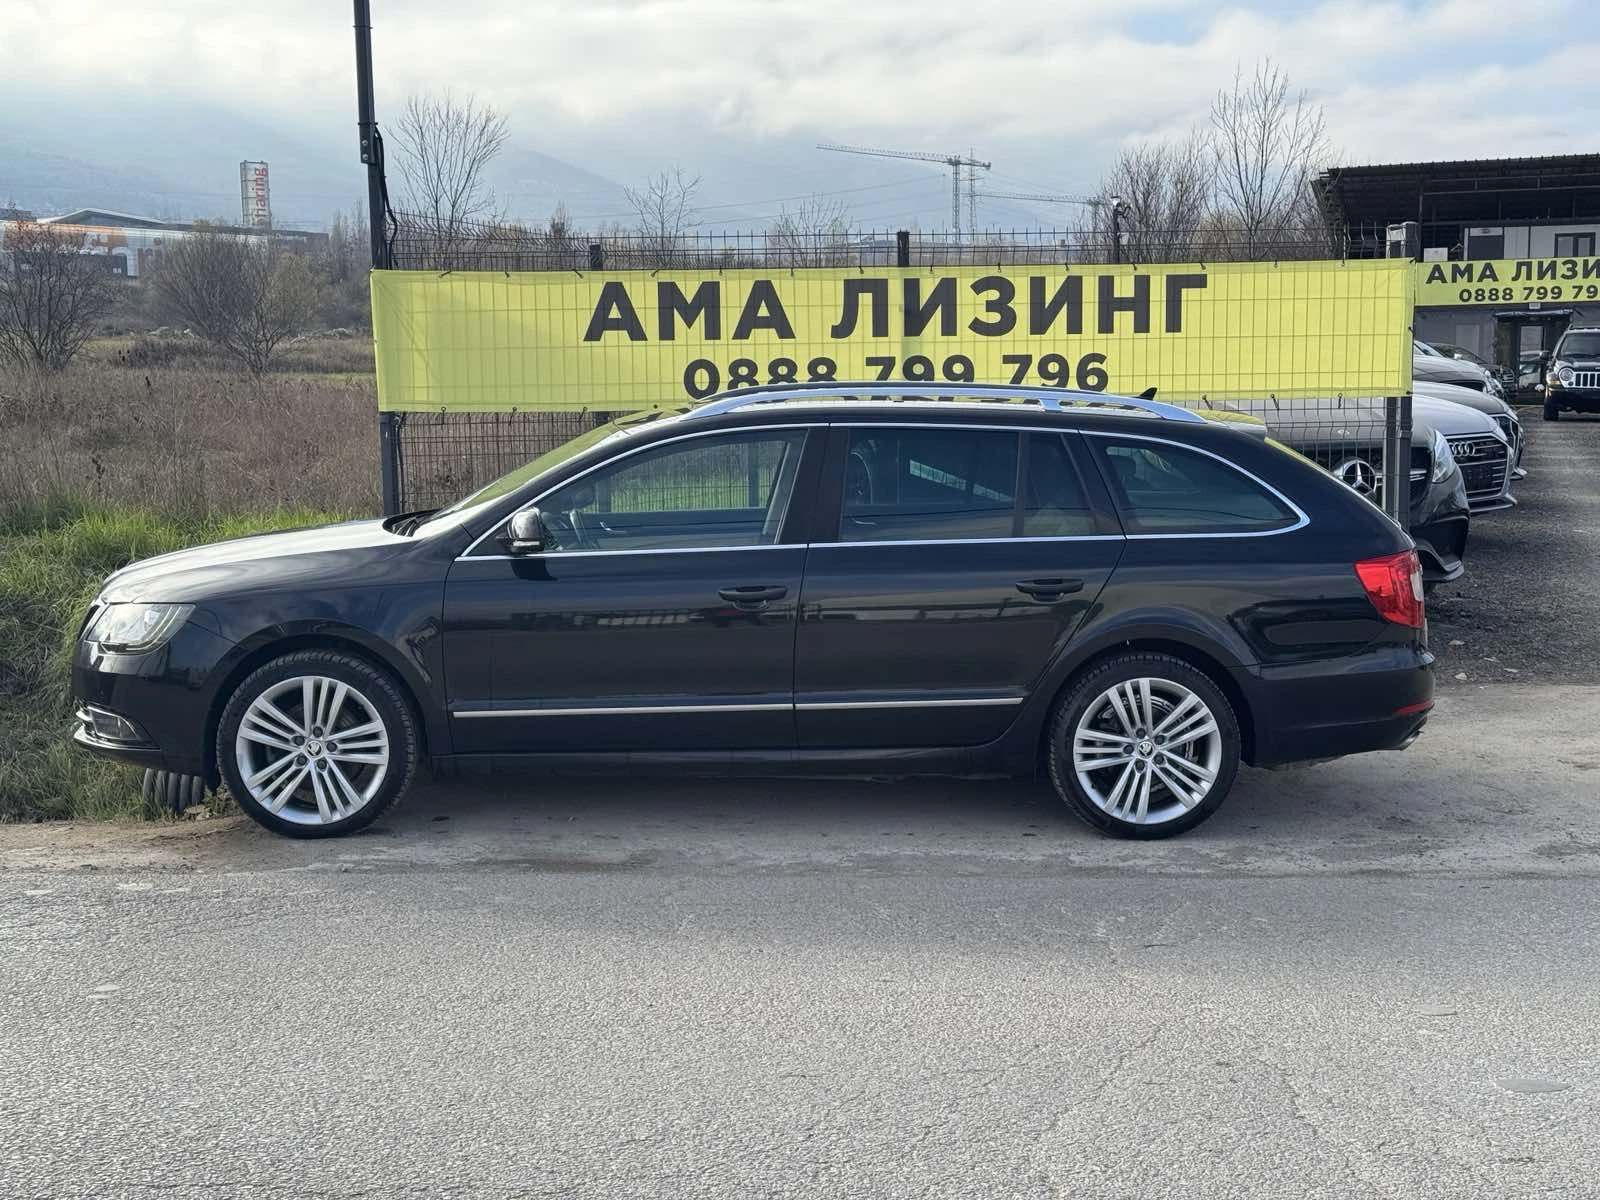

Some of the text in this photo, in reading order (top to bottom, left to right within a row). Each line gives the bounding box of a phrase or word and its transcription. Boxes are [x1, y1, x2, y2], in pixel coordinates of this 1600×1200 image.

[1425, 263, 1500, 284] АМА
[583, 273, 1208, 342] АМА ЛИЗИНГ
[1458, 286, 1514, 302] 0888
[1523, 285, 1563, 301] 799
[683, 356, 838, 400] 0888
[1001, 352, 1109, 393] 796
